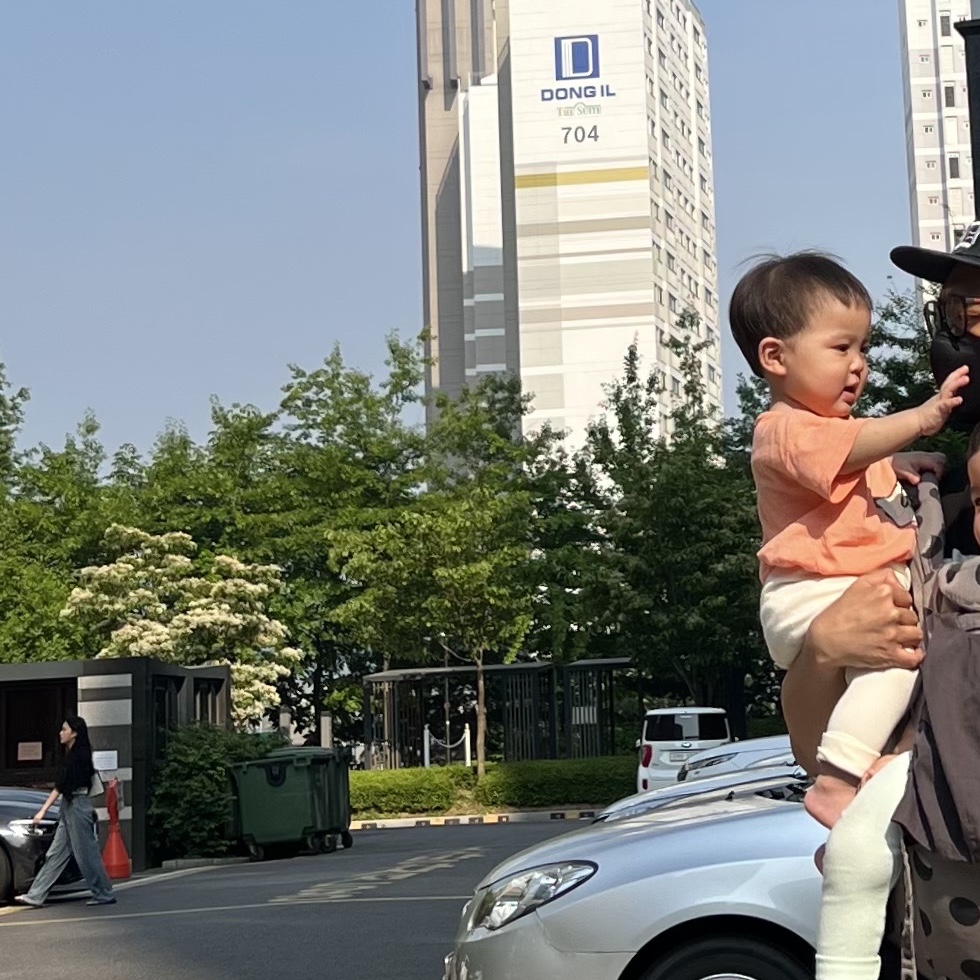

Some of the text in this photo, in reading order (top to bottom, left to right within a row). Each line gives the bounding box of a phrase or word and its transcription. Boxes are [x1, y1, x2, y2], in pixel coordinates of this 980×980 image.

[541, 84, 616, 101] DONG IL
[561, 124, 600, 144] 704
